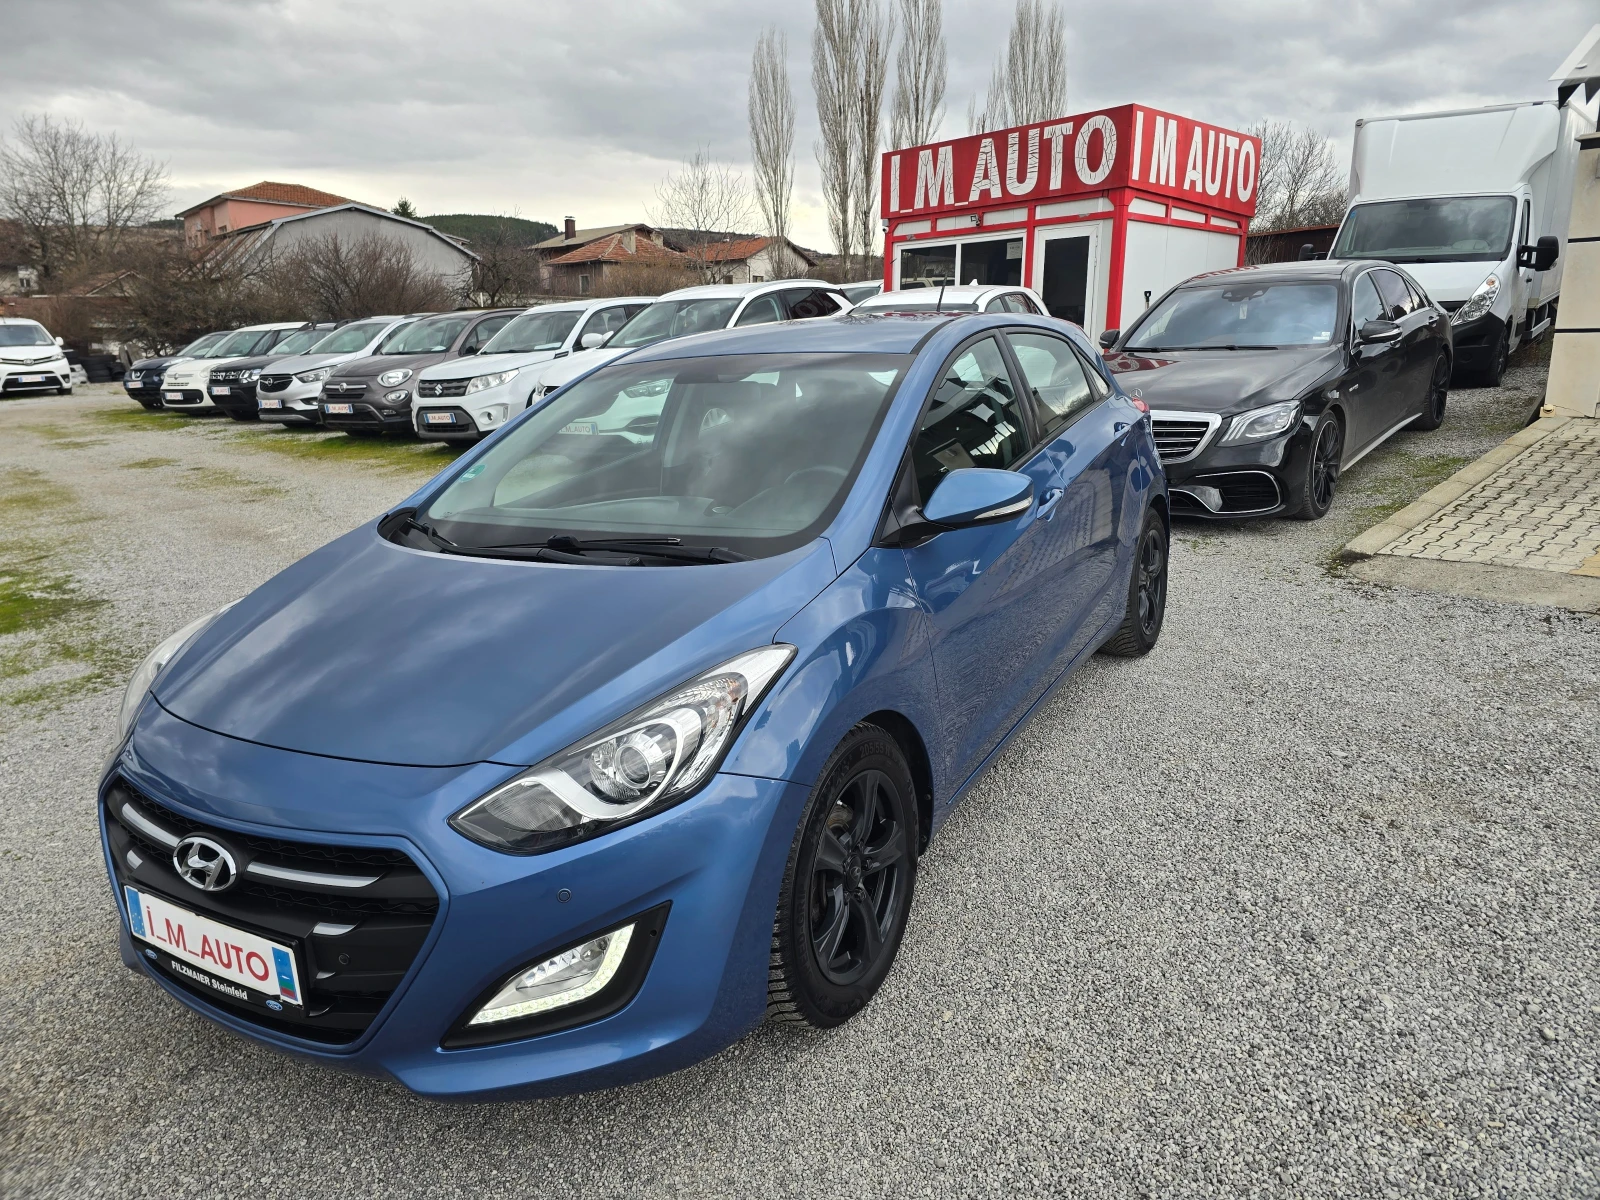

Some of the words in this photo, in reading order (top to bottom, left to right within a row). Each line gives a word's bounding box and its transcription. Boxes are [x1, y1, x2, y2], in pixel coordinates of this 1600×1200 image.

[1131, 110, 1144, 181] I
[1148, 115, 1177, 188] M
[1183, 126, 1256, 203] AUTO
[171, 960, 211, 986] FILZMAIER
[211, 978, 248, 1000] Steinfeld
